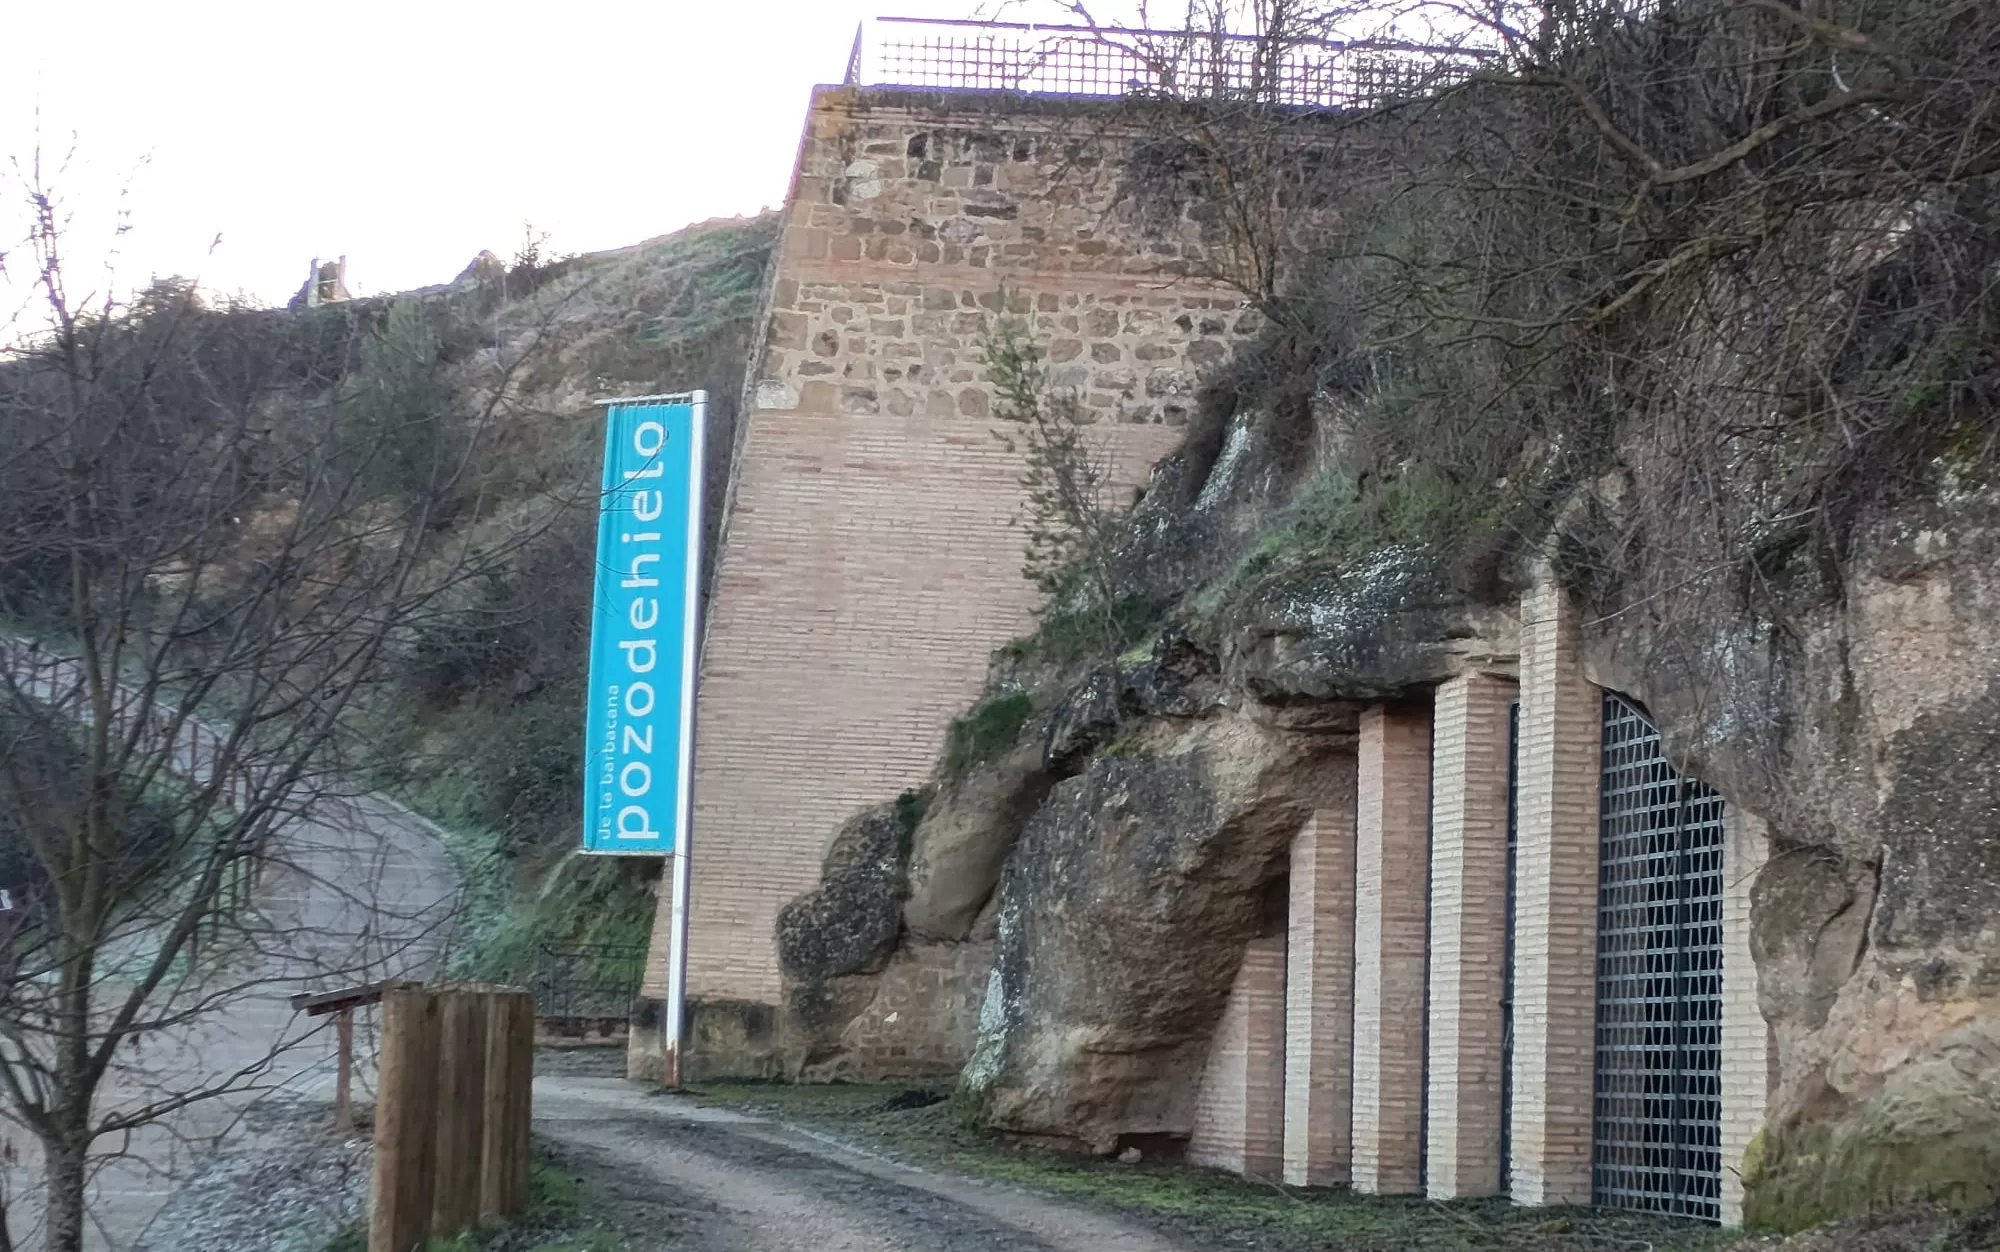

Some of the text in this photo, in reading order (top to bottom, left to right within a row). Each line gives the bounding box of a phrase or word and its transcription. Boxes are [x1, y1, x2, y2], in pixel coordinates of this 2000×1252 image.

[598, 684, 620, 840] de la barbacana
[617, 420, 668, 839] pozodehielo
